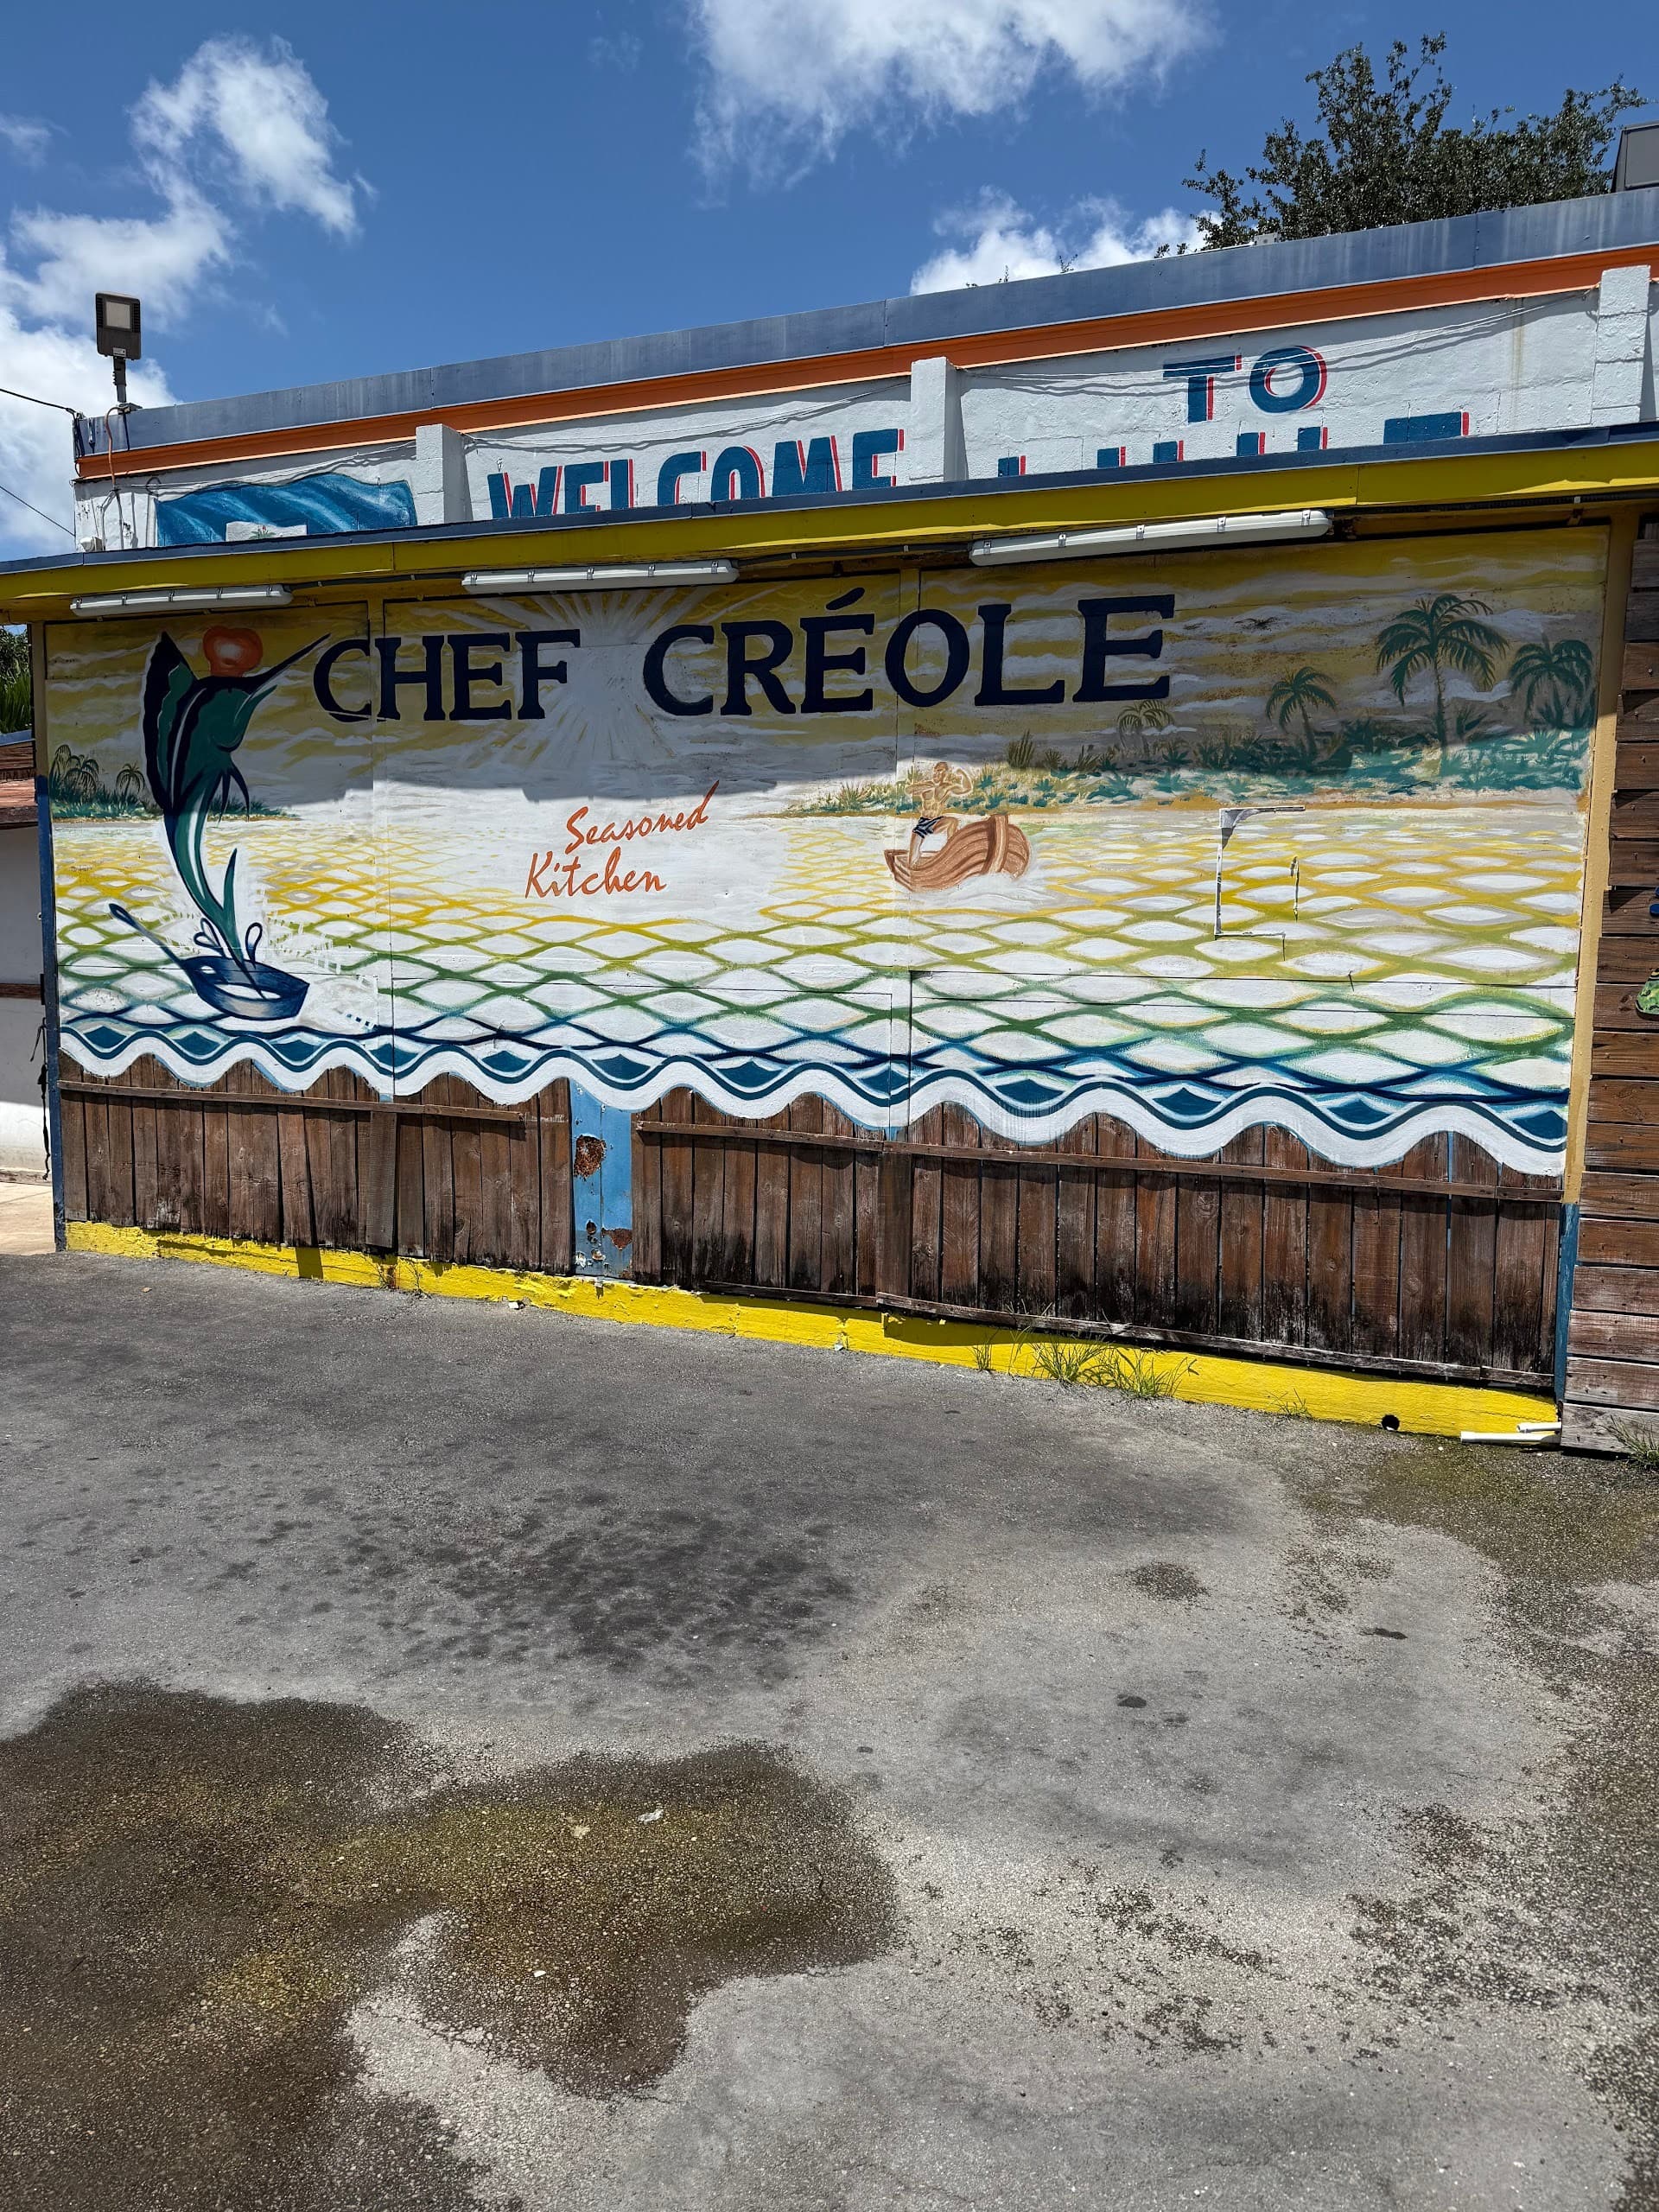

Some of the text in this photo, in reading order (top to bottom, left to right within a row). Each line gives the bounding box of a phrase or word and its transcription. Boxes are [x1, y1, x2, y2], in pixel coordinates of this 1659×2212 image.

[486, 428, 905, 518] WELCOME
[1163, 345, 1328, 423] TO
[313, 587, 1175, 722] CHEF CRÉOLE
[564, 779, 720, 855] Seasoned
[524, 846, 667, 899] Kitchen
